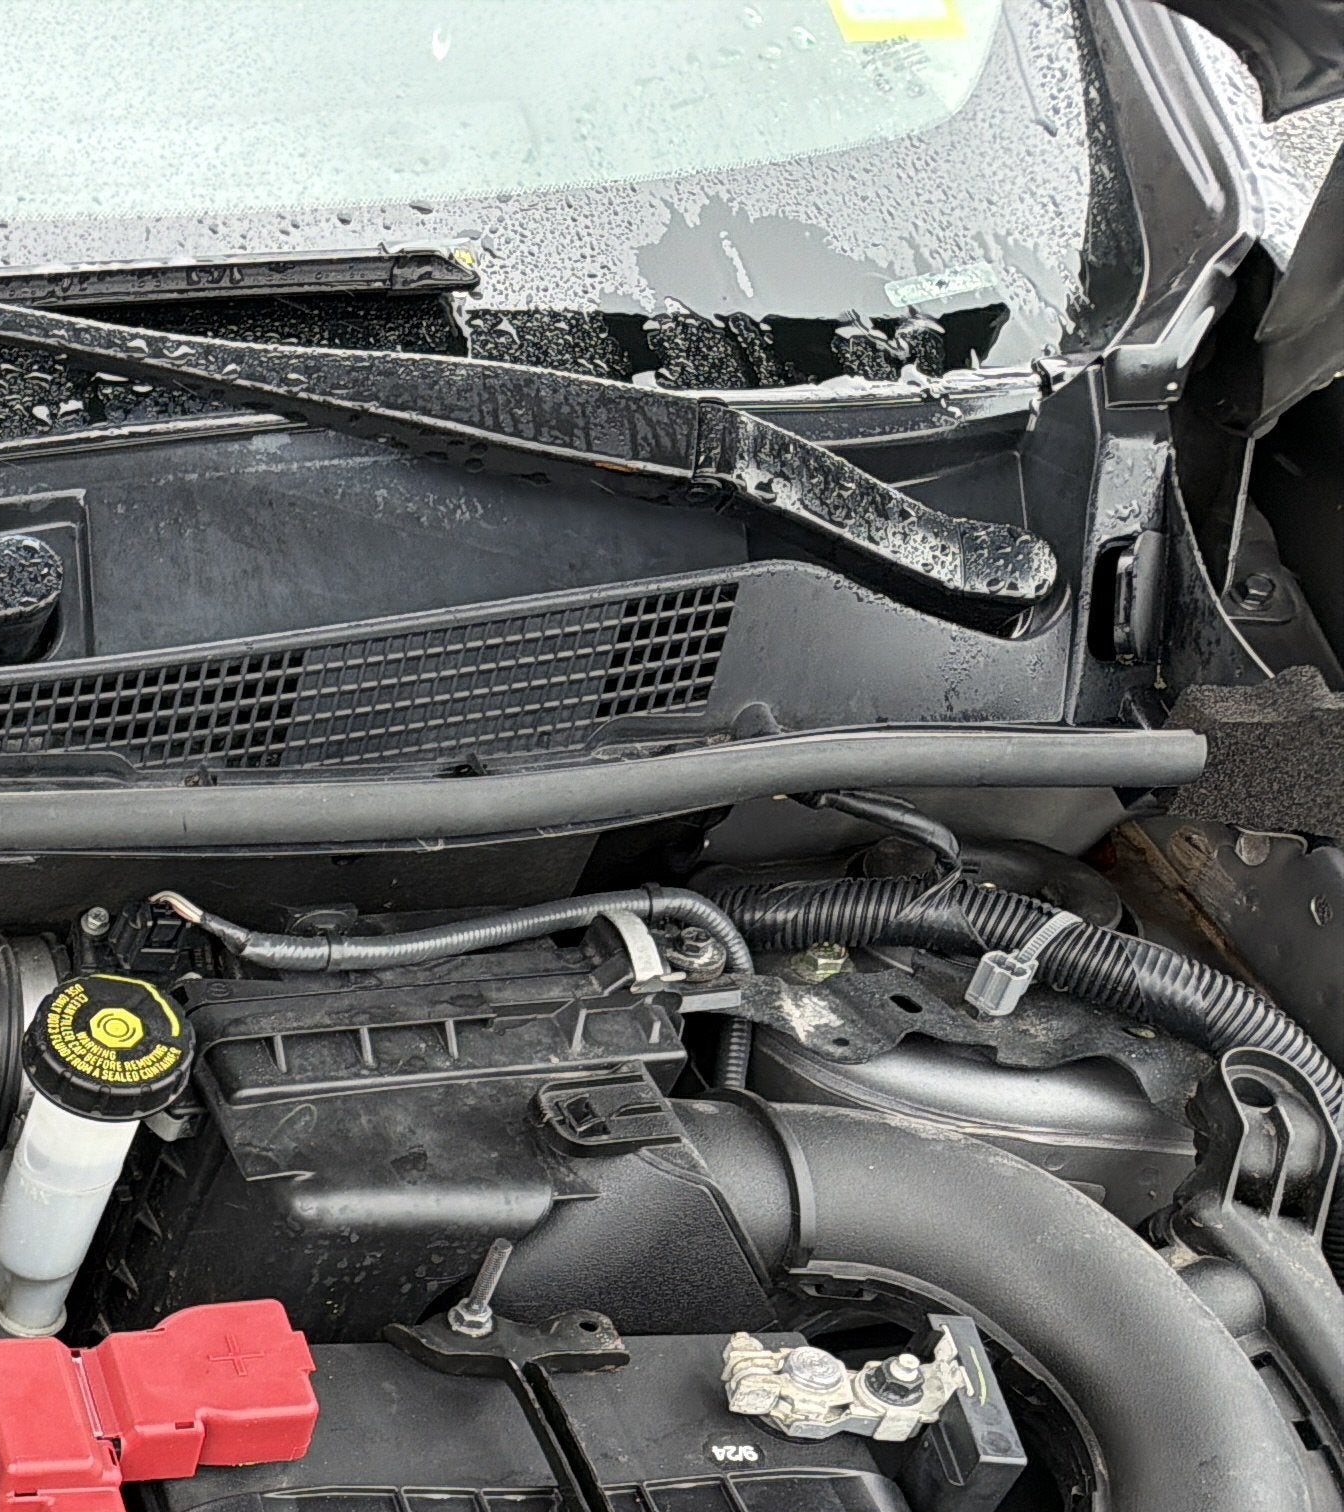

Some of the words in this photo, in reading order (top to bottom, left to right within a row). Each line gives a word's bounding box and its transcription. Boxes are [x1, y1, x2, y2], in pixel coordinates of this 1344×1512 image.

[64, 983, 85, 997] USE
[50, 993, 70, 1014] ONLY
[63, 993, 89, 1014] CLEAN
[60, 1014, 76, 1042] FILLER
[50, 1034, 72, 1058] FLUID
[68, 1041, 88, 1057] CAP
[75, 1031, 117, 1060] WARNING
[65, 1053, 94, 1074] FROM
[83, 1053, 123, 1072] BEFORE
[124, 1044, 169, 1071] REMOVING
[139, 1046, 183, 1080] CONTAINER
[92, 1067, 101, 1078] A
[101, 1070, 140, 1083] SEALED
[711, 1445, 758, 1462] 9/24
